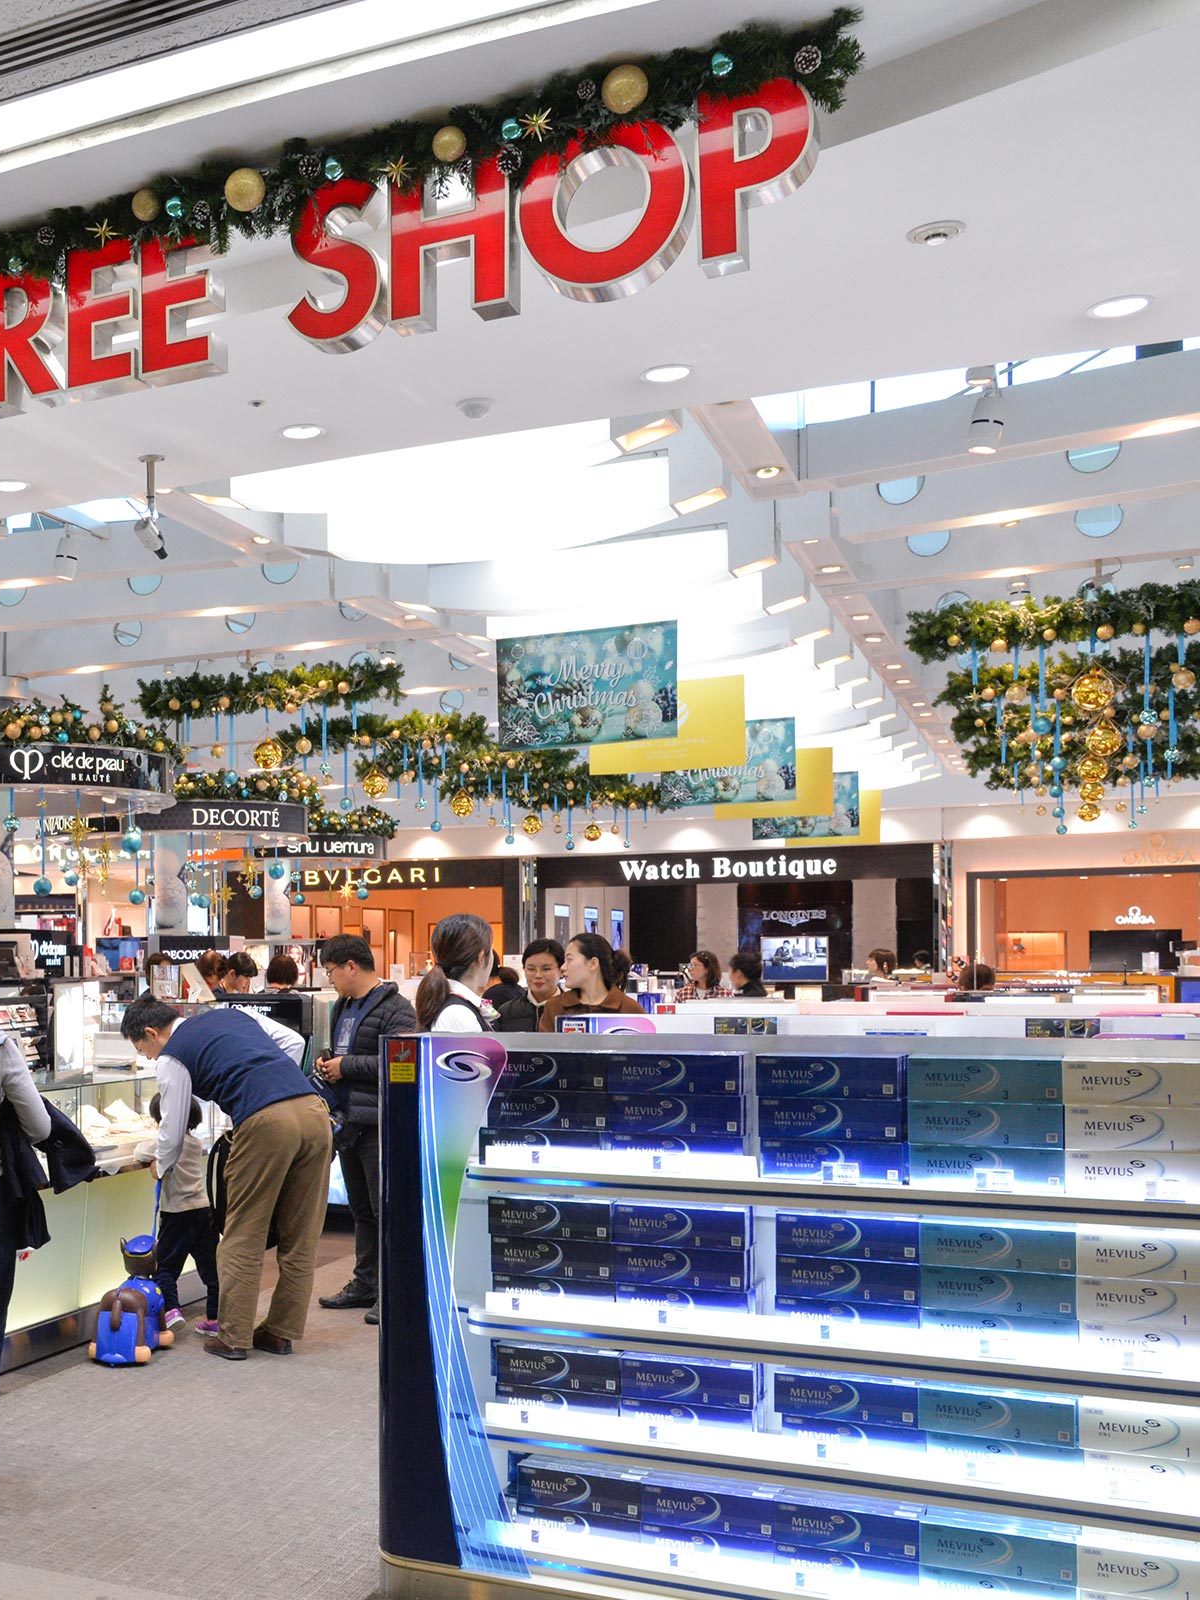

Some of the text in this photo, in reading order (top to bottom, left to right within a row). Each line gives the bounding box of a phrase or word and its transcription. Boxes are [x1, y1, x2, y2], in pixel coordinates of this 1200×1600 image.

[284, 77, 821, 354] SHOP
[548, 656, 625, 688] Merry
[534, 689, 639, 720] Christmas
[51, 751, 125, 774] clé de peau
[71, 773, 111, 783] BEAUTÉ
[687, 765, 765, 785] Christmas
[192, 808, 280, 828] DECORTÉ
[324, 842, 374, 855] uemura
[1123, 849, 1195, 865] OMEGA
[619, 855, 837, 881] Watch Boutique
[304, 867, 440, 886] BVLGARI
[762, 910, 826, 921] LONGINES
[1115, 915, 1155, 925] OMEGA
[162, 949, 204, 960] DECORT
[622, 1066, 661, 1076] MEVIUS
[771, 1069, 814, 1079] MEVIUS
[925, 1072, 970, 1082] MEVIUS
[1081, 1076, 1131, 1086] MEVIUS
[559, 1079, 568, 1089] 10
[689, 1082, 694, 1092] 8
[843, 1086, 849, 1097] 6
[1002, 1090, 1009, 1100] 3
[1168, 1094, 1171, 1105] 1
[500, 1102, 537, 1112] MEVIUS
[624, 1106, 663, 1116] MEVIUS
[774, 1111, 816, 1121] MEVIUS
[925, 1116, 971, 1126] MEVIUS
[560, 1118, 569, 1128] 10
[690, 1122, 696, 1133] 8
[1084, 1121, 1133, 1132] MEVIUS
[846, 1128, 851, 1139] 6
[1003, 1134, 1010, 1145] 3
[1170, 1140, 1174, 1151] 1
[776, 1153, 818, 1162] MEVIUS
[927, 1159, 972, 1170] MEVIUS
[1084, 1166, 1134, 1177] MEVIUS
[501, 1210, 537, 1220] MEVIUS
[629, 1218, 667, 1229] MEVIUS
[562, 1227, 570, 1237] 10
[792, 1228, 834, 1239] MEVIUS
[695, 1236, 700, 1246] 8
[937, 1237, 983, 1249] MEVIUS
[504, 1248, 540, 1259] MEVIUS
[864, 1247, 870, 1258] 6
[1096, 1248, 1146, 1260] MEVIUS
[628, 1258, 667, 1268] MEVIUS
[1016, 1258, 1022, 1269] 3
[564, 1266, 573, 1277] 10
[792, 1270, 834, 1281] MEVIUS
[1183, 1269, 1187, 1280] 1
[694, 1276, 699, 1287] 8
[937, 1281, 983, 1293] MEVIUS
[864, 1290, 870, 1300] 6
[1096, 1292, 1146, 1305] MEVIUS
[1016, 1302, 1022, 1313] 3
[1183, 1314, 1187, 1326] 1
[509, 1359, 546, 1371] MEVIUS
[636, 1372, 675, 1384] MEVIUS
[570, 1379, 579, 1389] 10
[703, 1393, 708, 1403] 8
[790, 1388, 833, 1400] MEVIUS
[508, 1397, 545, 1408] MEVIUS
[862, 1410, 868, 1421] 6
[935, 1403, 982, 1417] MEVIUS
[635, 1411, 674, 1422] MEVIUS
[1014, 1428, 1021, 1439] 3
[1099, 1422, 1149, 1435] MEVIUS
[798, 1430, 841, 1441] MEVIUS
[1186, 1447, 1190, 1458] 1
[531, 1479, 568, 1492] MEVIUS
[592, 1502, 601, 1513] 10
[657, 1499, 696, 1511] MEVIUS
[530, 1518, 567, 1531] MEVIUS
[724, 1521, 729, 1532] 8
[792, 1517, 834, 1531] MEVIUS
[655, 1537, 695, 1551] MEVIUS
[864, 1542, 870, 1552] 6
[937, 1539, 984, 1553] MEVIUS
[790, 1558, 833, 1570] MEVIUS
[1016, 1566, 1023, 1576] 3
[1097, 1562, 1147, 1578] MEVIUS
